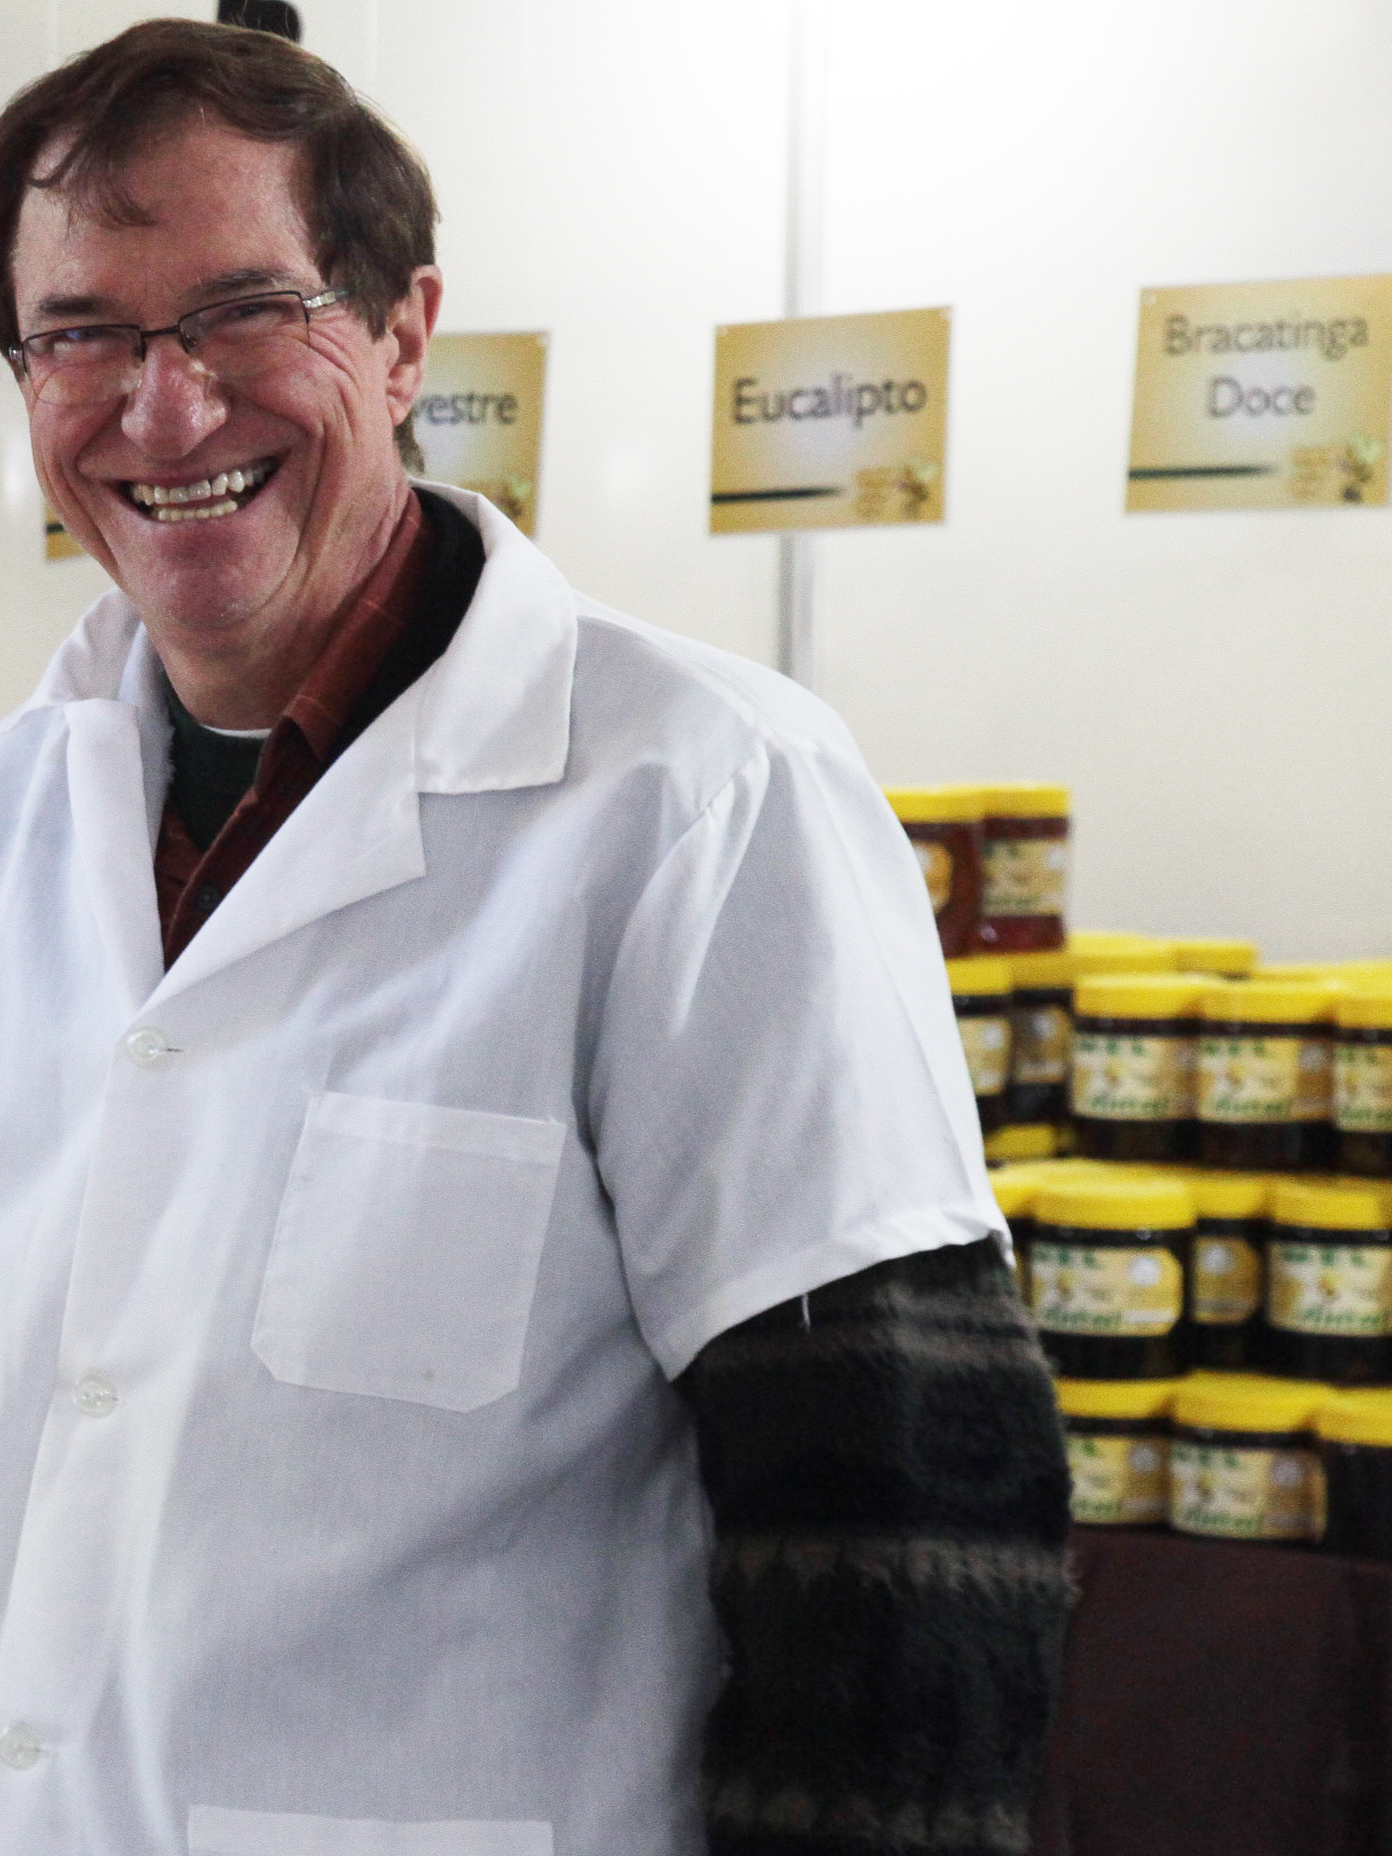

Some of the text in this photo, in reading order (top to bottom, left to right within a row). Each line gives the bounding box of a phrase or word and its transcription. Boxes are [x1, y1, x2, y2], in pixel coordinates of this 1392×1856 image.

[1164, 312, 1370, 362] Bracatinga
[732, 370, 927, 430] Eucalipto
[1209, 375, 1315, 418] Doce
